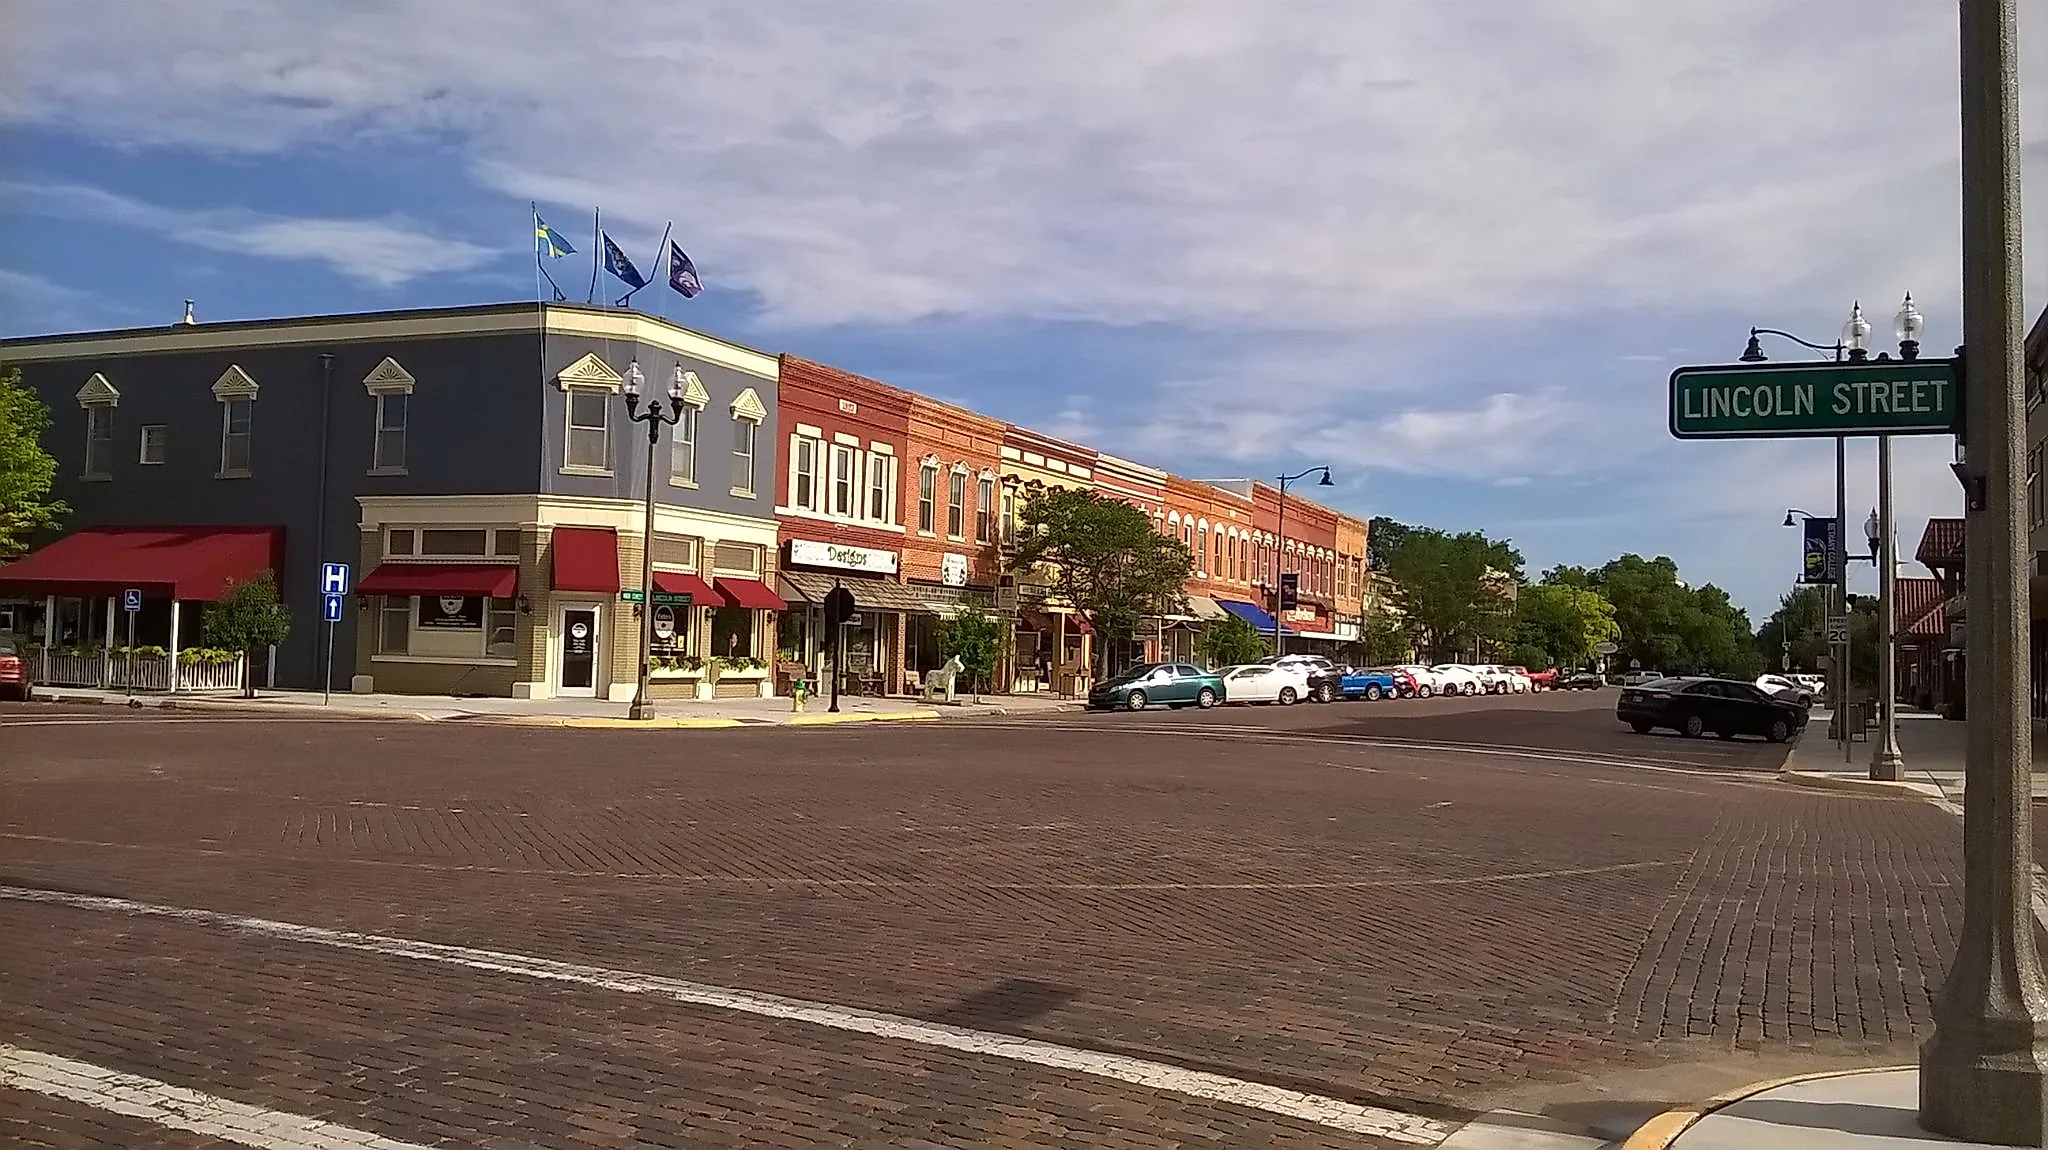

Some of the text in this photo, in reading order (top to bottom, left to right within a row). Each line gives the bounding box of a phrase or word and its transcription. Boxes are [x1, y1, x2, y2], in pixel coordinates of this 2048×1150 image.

[1684, 379, 1949, 418] LINCOLN STREET
[827, 546, 867, 567] Designs
[325, 565, 345, 592] H
